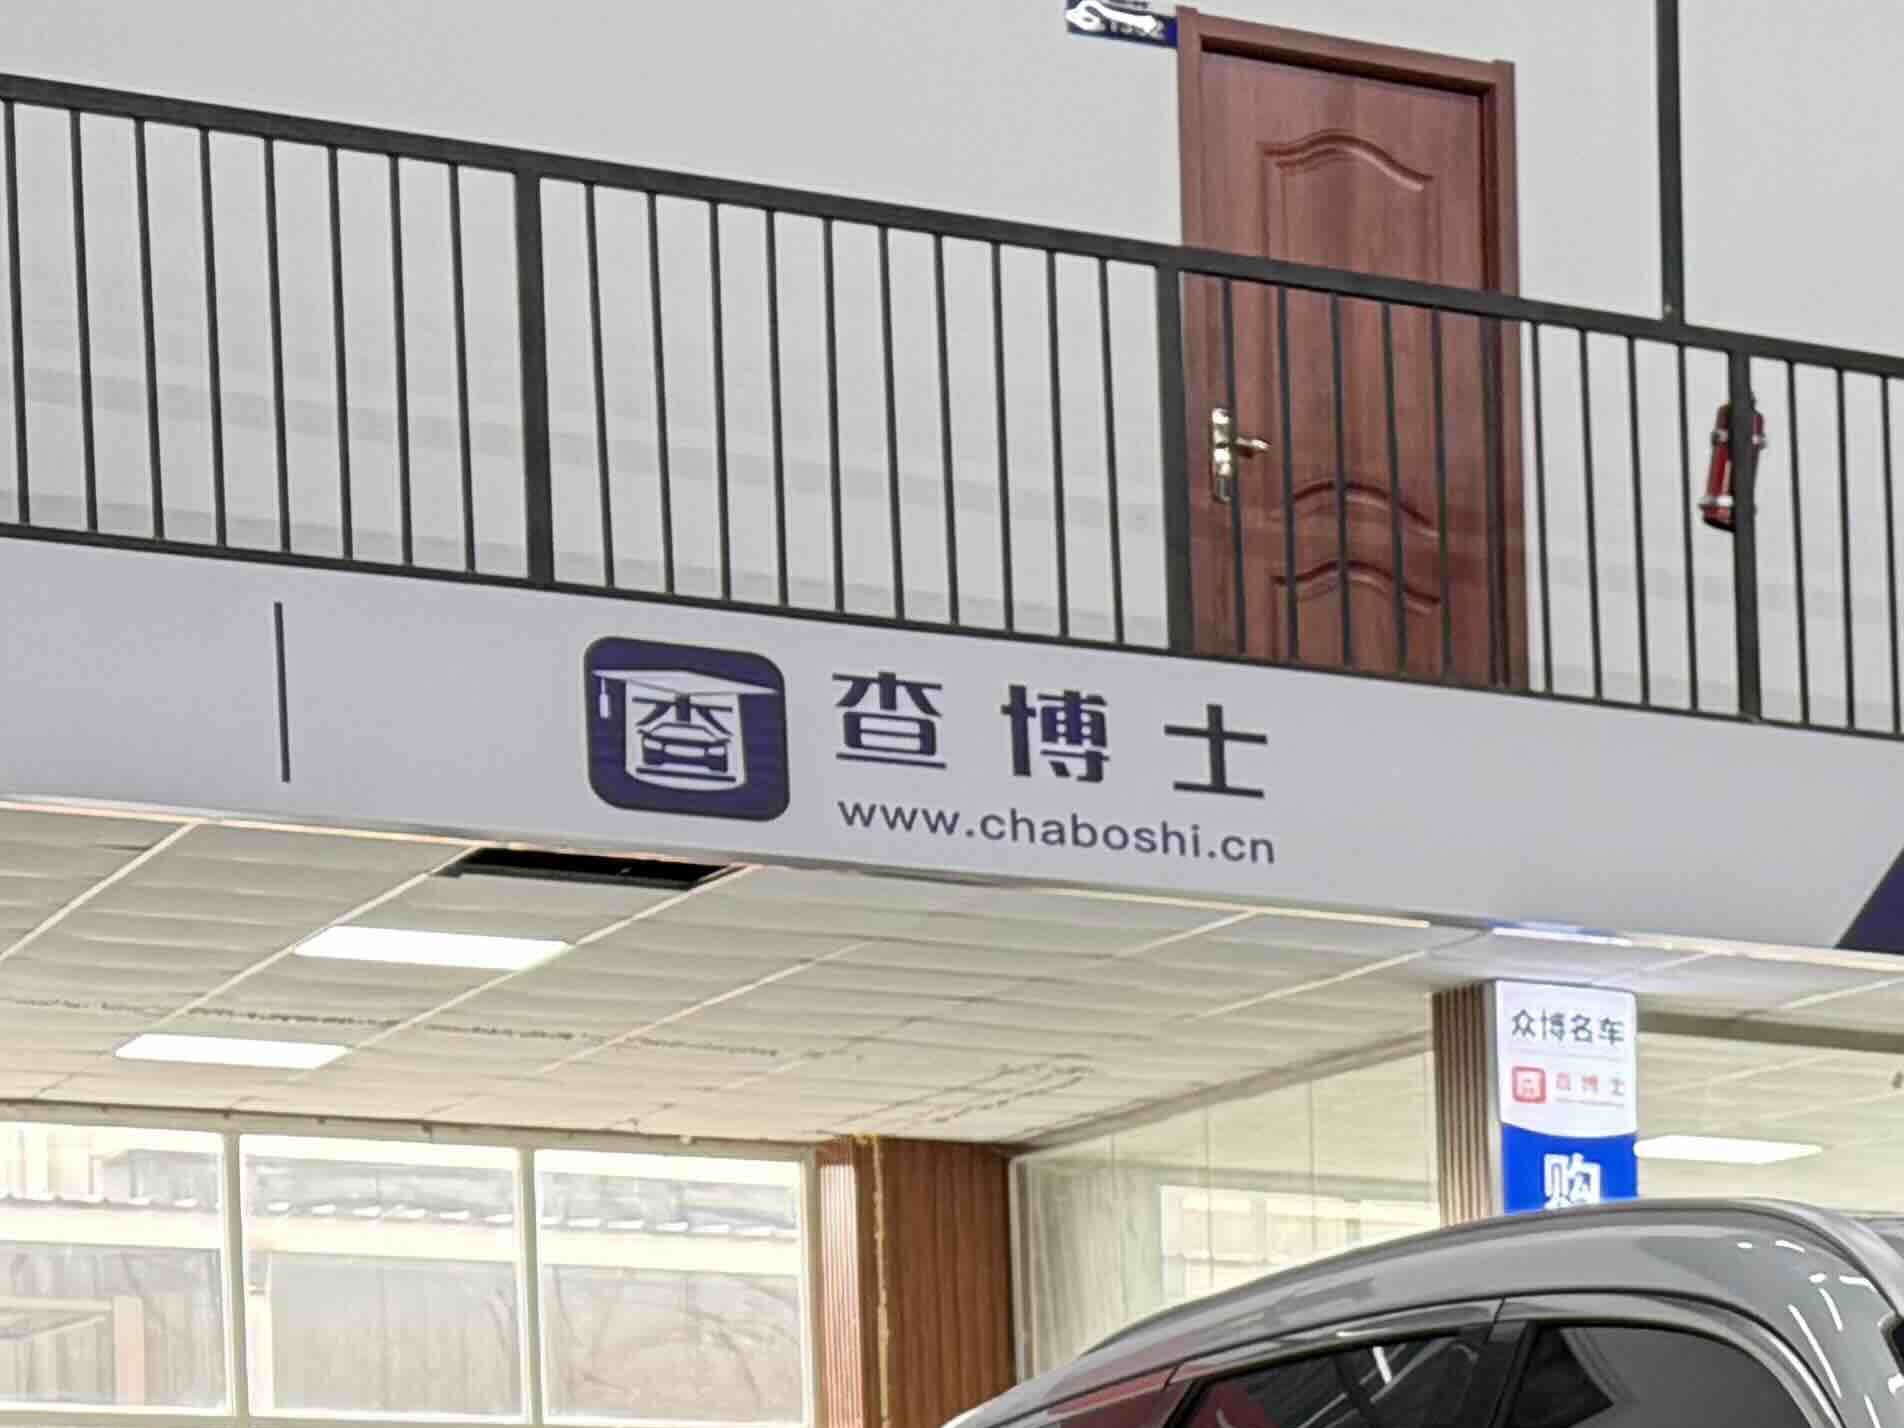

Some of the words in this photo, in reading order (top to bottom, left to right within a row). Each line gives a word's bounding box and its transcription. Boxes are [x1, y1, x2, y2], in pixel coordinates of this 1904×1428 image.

[831, 670, 1269, 799] 查博士
[837, 800, 1277, 866] www.chaboshi.cn
[1511, 1008, 1625, 1046] 众博名车
